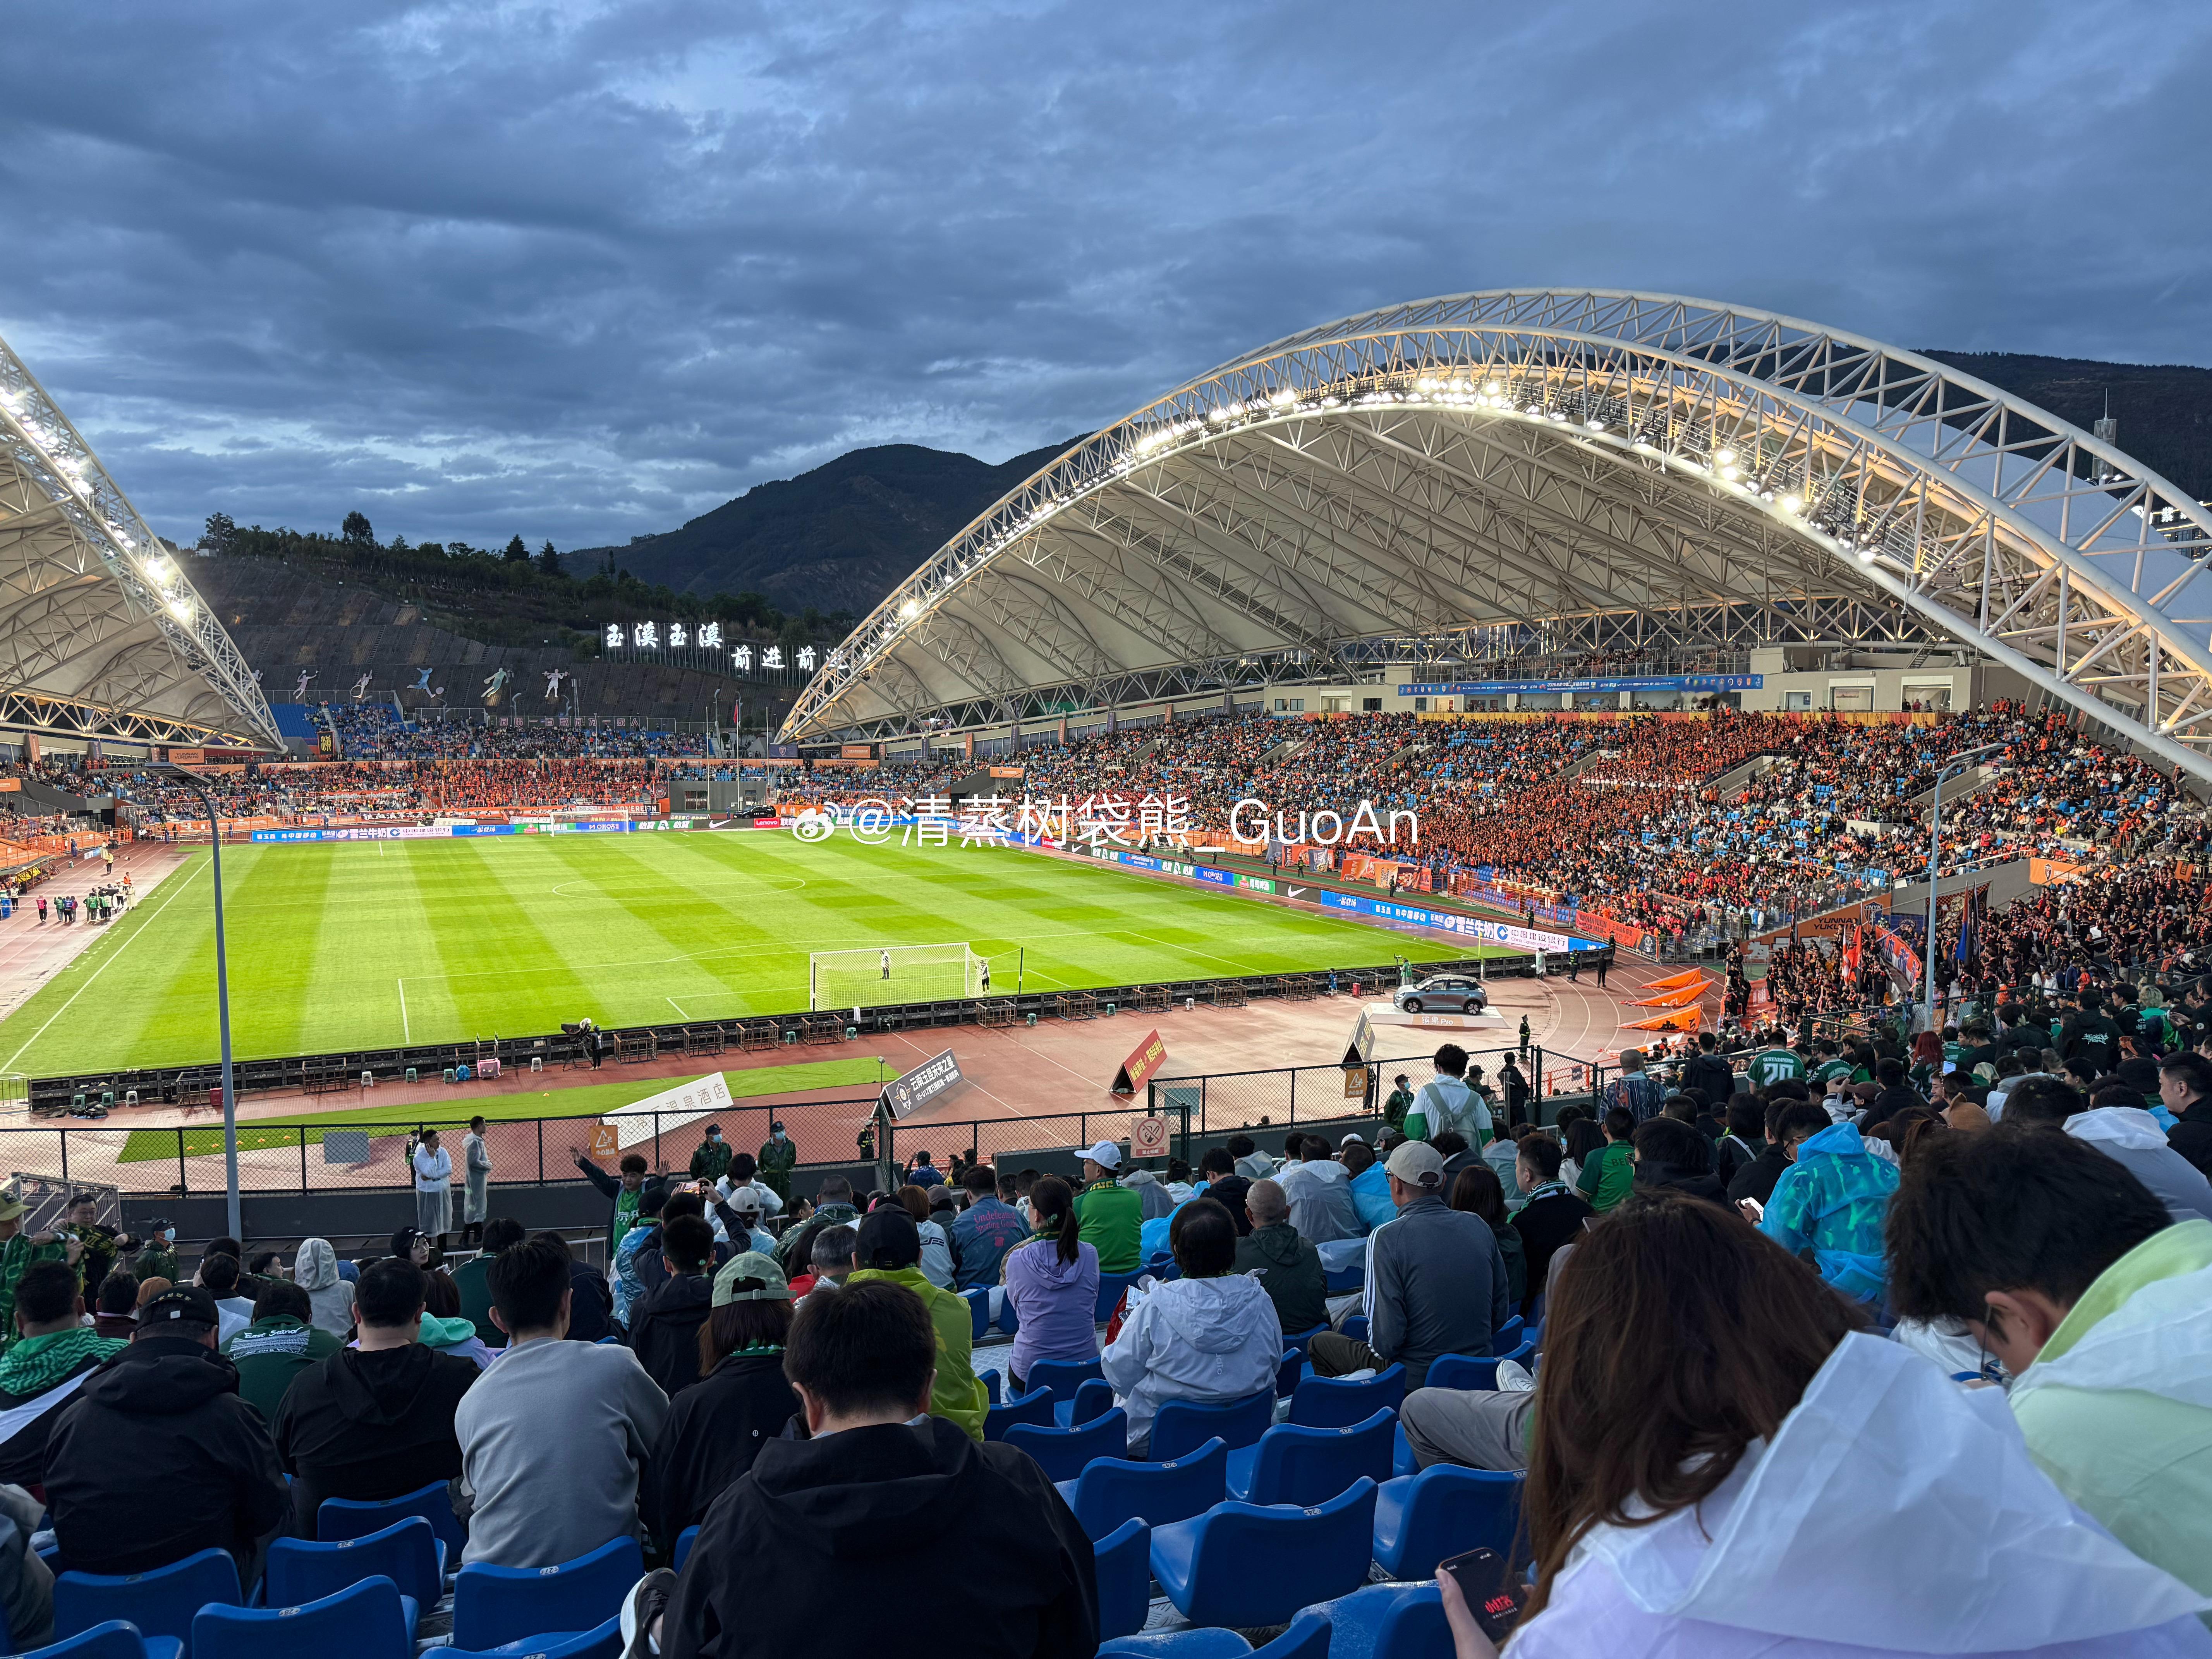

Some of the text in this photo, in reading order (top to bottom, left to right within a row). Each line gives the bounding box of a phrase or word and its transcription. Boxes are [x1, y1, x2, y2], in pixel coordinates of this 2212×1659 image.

[607, 621, 723, 649] 玉溪玉溪
[731, 644, 848, 671] 前进前进
[350, 828, 387, 838] 雪兰牛奶
[1456, 916, 1494, 939] 雪兰牛奶
[1511, 929, 1566, 946] 中国建设银行
[910, 1055, 955, 1091] 云南玉昆未来之星
[1763, 1063, 1794, 1086] 20
[974, 1209, 1016, 1223] Undefeated
[975, 1221, 1000, 1232] Sporting
[269, 1327, 304, 1337] Stand
